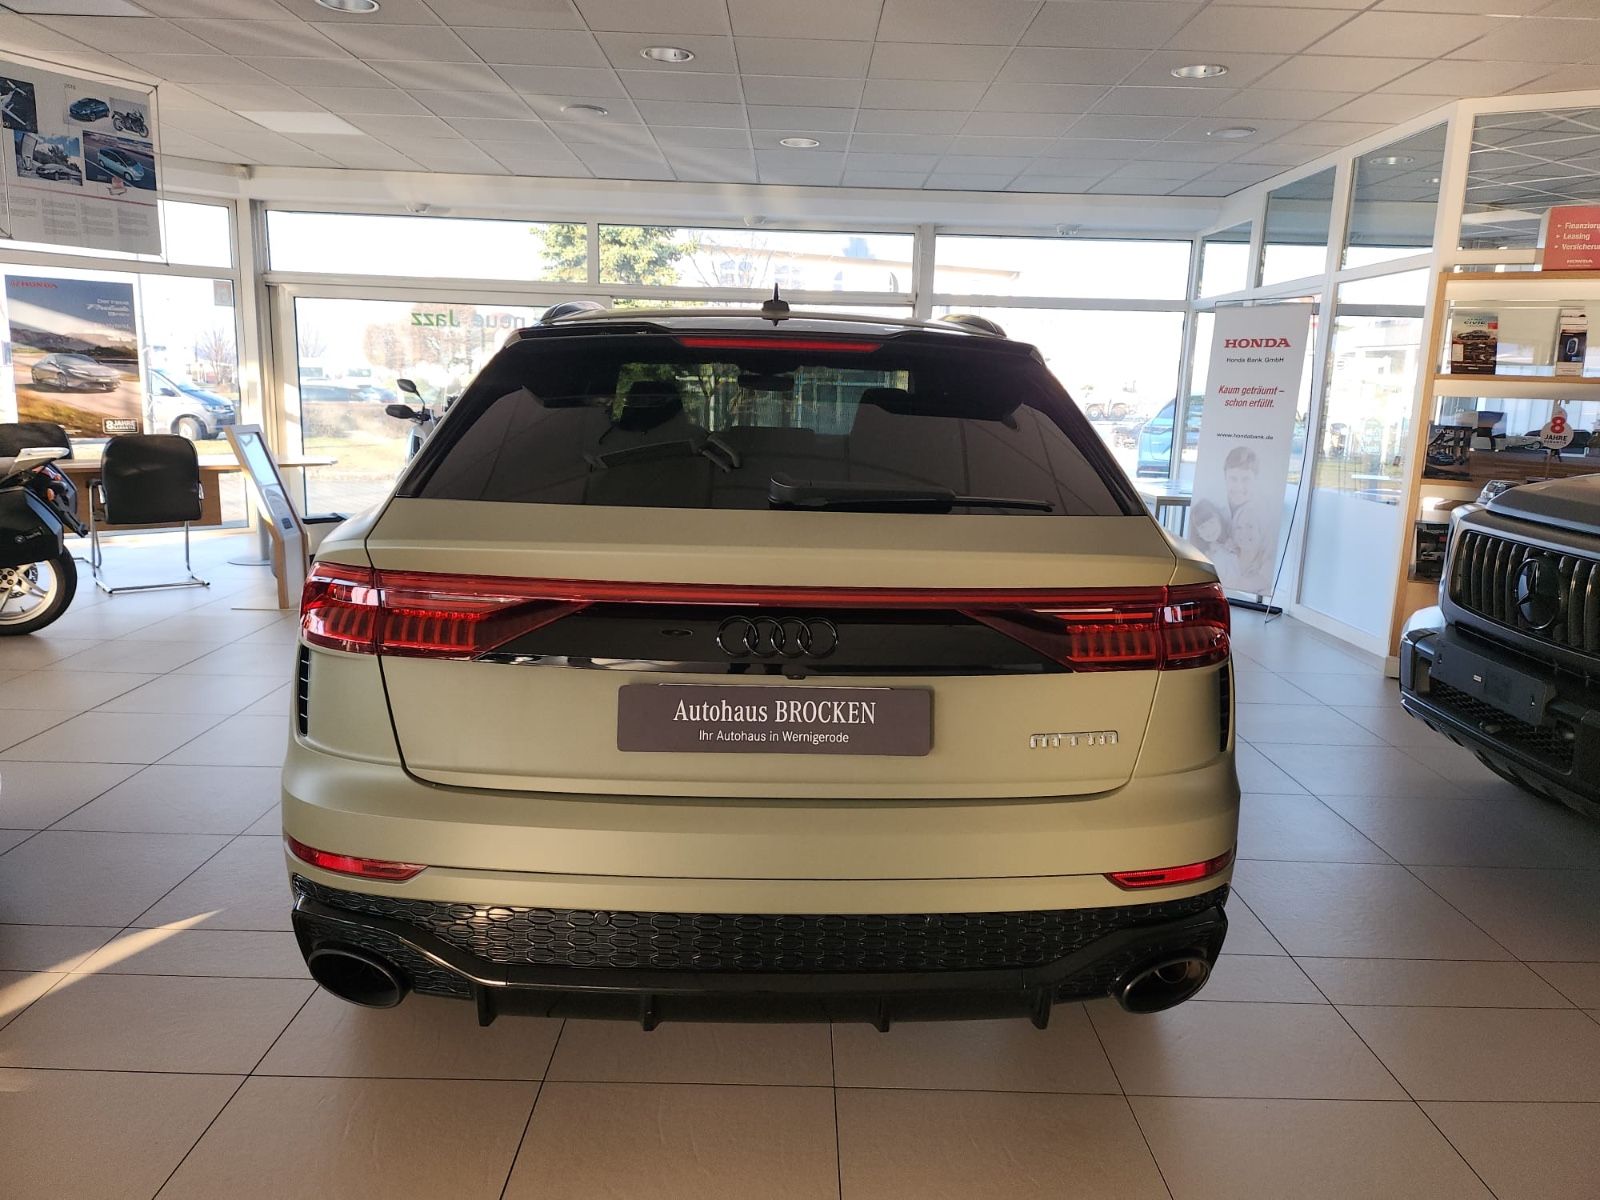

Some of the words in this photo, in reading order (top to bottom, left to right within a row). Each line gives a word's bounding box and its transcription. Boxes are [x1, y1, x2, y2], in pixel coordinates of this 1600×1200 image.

[1563, 233, 1590, 241] Leasing
[1224, 338, 1291, 349] HONDA
[1218, 385, 1240, 394] Kaum
[1241, 386, 1278, 396] geträumt
[1224, 399, 1248, 407] schon
[1248, 399, 1274, 408] erfüllt.
[105, 420, 114, 430] 8
[1550, 416, 1565, 434] 8
[1216, 432, 1274, 440] www.hondabank.de
[672, 699, 768, 722] Autohaus
[774, 700, 876, 724] BROCKEN
[699, 730, 713, 741] Ihr
[716, 730, 766, 742] Autohaus
[769, 731, 779, 742] in
[782, 731, 849, 745] Wernigerode
